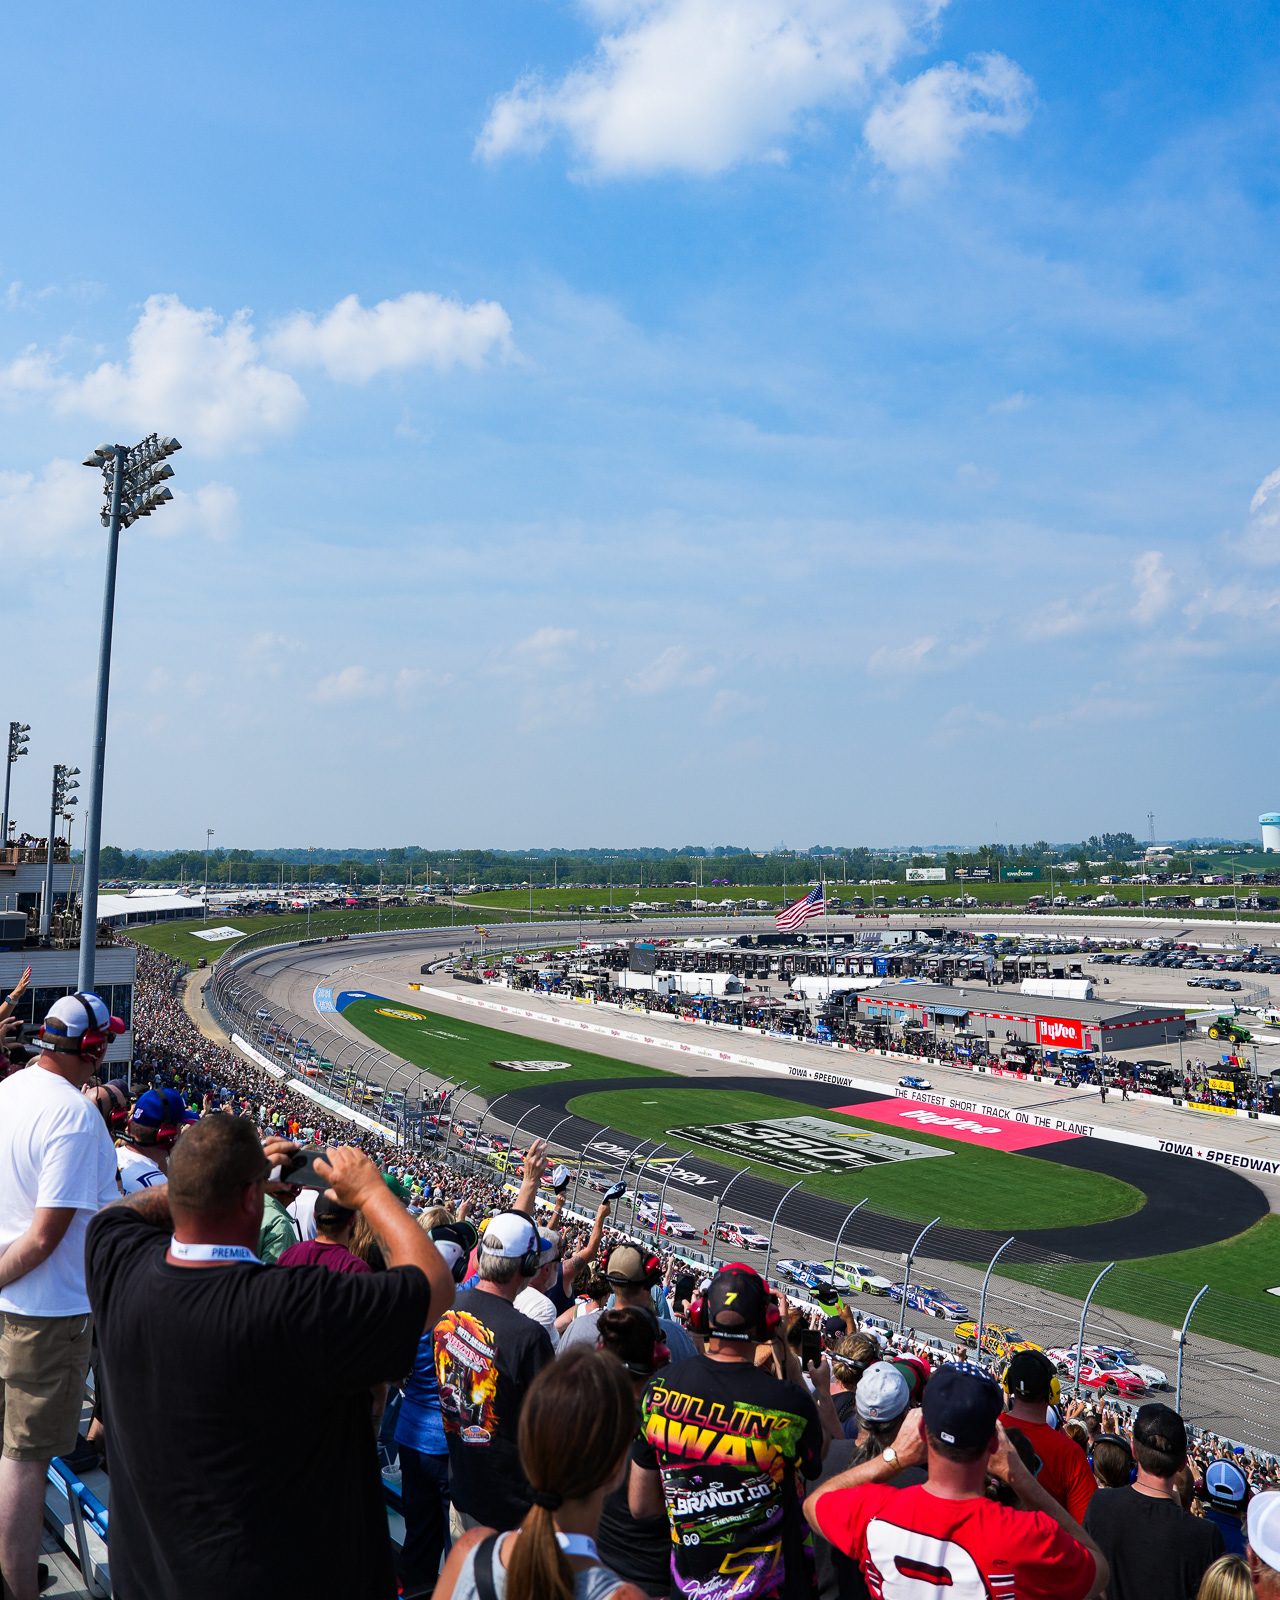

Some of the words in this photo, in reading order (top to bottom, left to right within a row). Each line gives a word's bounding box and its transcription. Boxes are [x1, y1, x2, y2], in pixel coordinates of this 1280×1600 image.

[788, 1066, 808, 1078] IOWA
[814, 1072, 853, 1087] SPEEDWAY
[895, 1087, 908, 1098] THE
[912, 1091, 945, 1106] FASTEST
[950, 1099, 977, 1112] SHORT
[982, 1105, 1011, 1119] TRACK
[1016, 1112, 1029, 1124] ON
[1035, 1116, 1050, 1128] THE
[1056, 1120, 1094, 1136] PLANET
[730, 1128, 866, 1159] 350
[1159, 1140, 1193, 1157] IOWA
[1206, 1150, 1280, 1174] SPEEDWAY
[212, 1247, 251, 1258] PREMIER
[800, 1271, 810, 1282] 21
[724, 1292, 738, 1305] 7
[916, 1296, 925, 1310] 11
[1080, 1366, 1092, 1375] 2
[650, 1386, 791, 1439] PULLIN'
[646, 1414, 782, 1472] AWAY
[712, 1514, 750, 1527] CHEVROLET
[718, 1540, 782, 1600] 7
